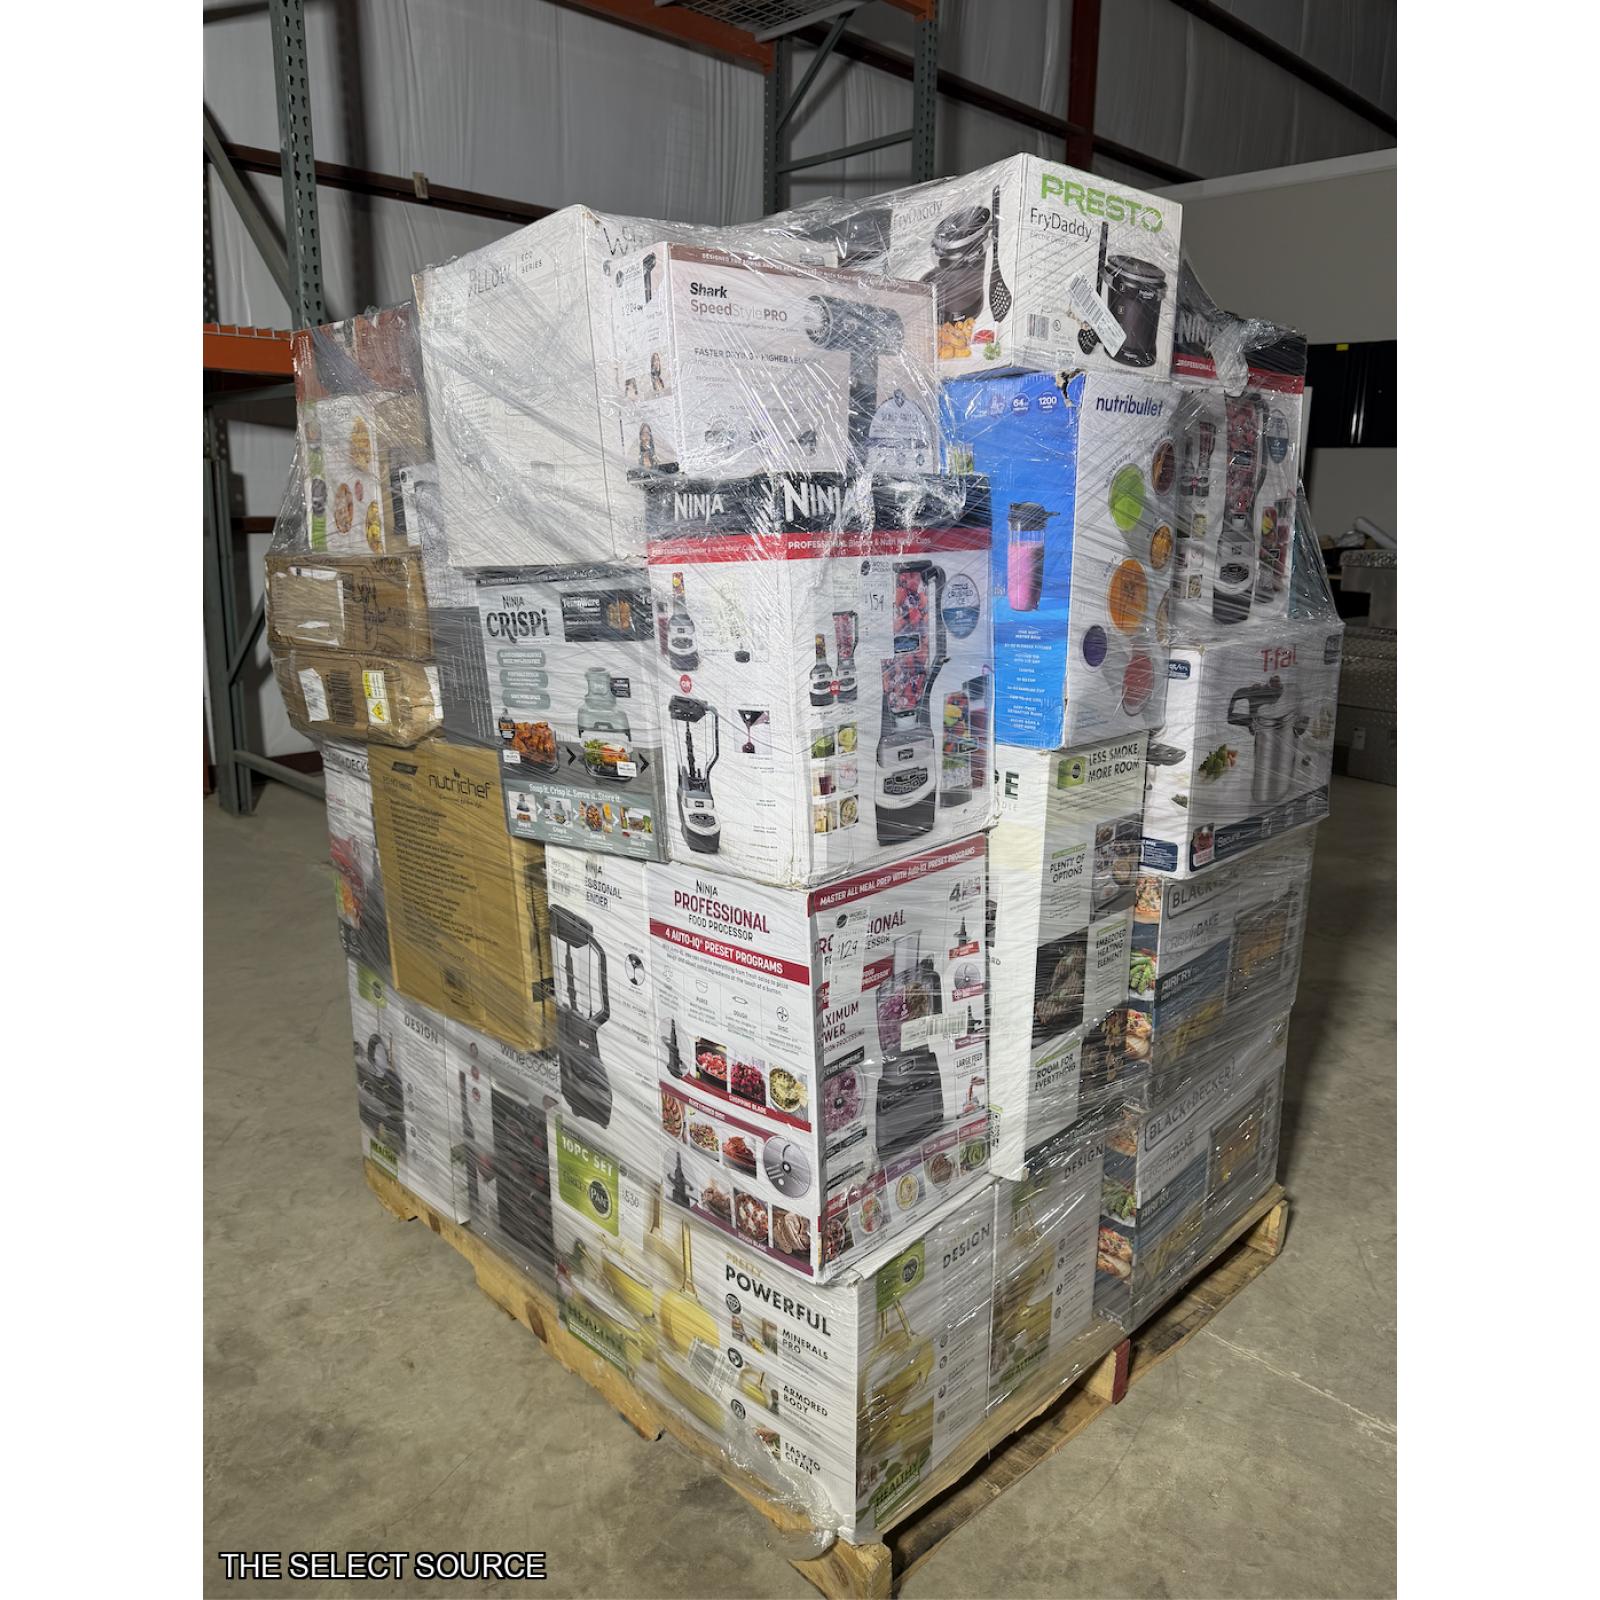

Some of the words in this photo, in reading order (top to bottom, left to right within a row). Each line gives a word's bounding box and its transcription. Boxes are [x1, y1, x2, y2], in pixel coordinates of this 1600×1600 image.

[1040, 174, 1164, 233] PRESTO
[1030, 207, 1092, 242] FryDaddy
[690, 282, 728, 299] Shark
[690, 299, 788, 322] SpeedStylePRO
[694, 347, 723, 359] FASTER
[1038, 395, 1057, 406] 1200
[1096, 394, 1164, 417] nutribullet
[674, 491, 724, 525] NINJA
[784, 479, 864, 525] NINJA
[502, 594, 525, 611] NINJA
[486, 608, 550, 644] CRISPi
[1260, 645, 1298, 673] T-fal
[1089, 751, 1107, 766] LESS
[1089, 766, 1112, 783] MORE
[1114, 759, 1140, 775] ROOM
[428, 773, 492, 800] nutrichef
[820, 890, 846, 906] MASTER
[846, 887, 859, 899] ALL
[859, 881, 875, 895] MEAL
[876, 875, 892, 889] PREP
[892, 870, 907, 885] WITH
[928, 855, 947, 870] PRESET
[947, 846, 975, 863] PROGRAMS
[1050, 858, 1075, 874] PLENTY
[1076, 854, 1085, 866] OF
[1053, 865, 1083, 884] OPTIONS
[586, 891, 609, 909] ENDER
[696, 879, 719, 897] NINJA
[674, 889, 771, 934] PROFESSIONAL
[689, 913, 707, 928] FOOD
[708, 919, 754, 942] PROCESSOR
[665, 927, 671, 938] 4
[705, 940, 734, 960] PRESET
[735, 947, 783, 974] PROGRAMS
[1161, 969, 1192, 991] AIRFRY
[404, 1014, 439, 1044] DESIGN
[1037, 1063, 1058, 1080] ROOM
[1060, 1053, 1074, 1068] FOR
[562, 1136, 589, 1162] 10PC
[593, 1155, 613, 1177] SET
[1064, 1144, 1105, 1180] DESIGN
[942, 1223, 991, 1269] DESIGN
[725, 1264, 832, 1337] POWERFUL
[782, 1328, 830, 1361] MINERALS
[782, 1339, 801, 1355] PRO
[783, 1384, 829, 1418] ARMORED
[783, 1393, 809, 1415] BODY
[785, 1450, 813, 1475] CLEAN
